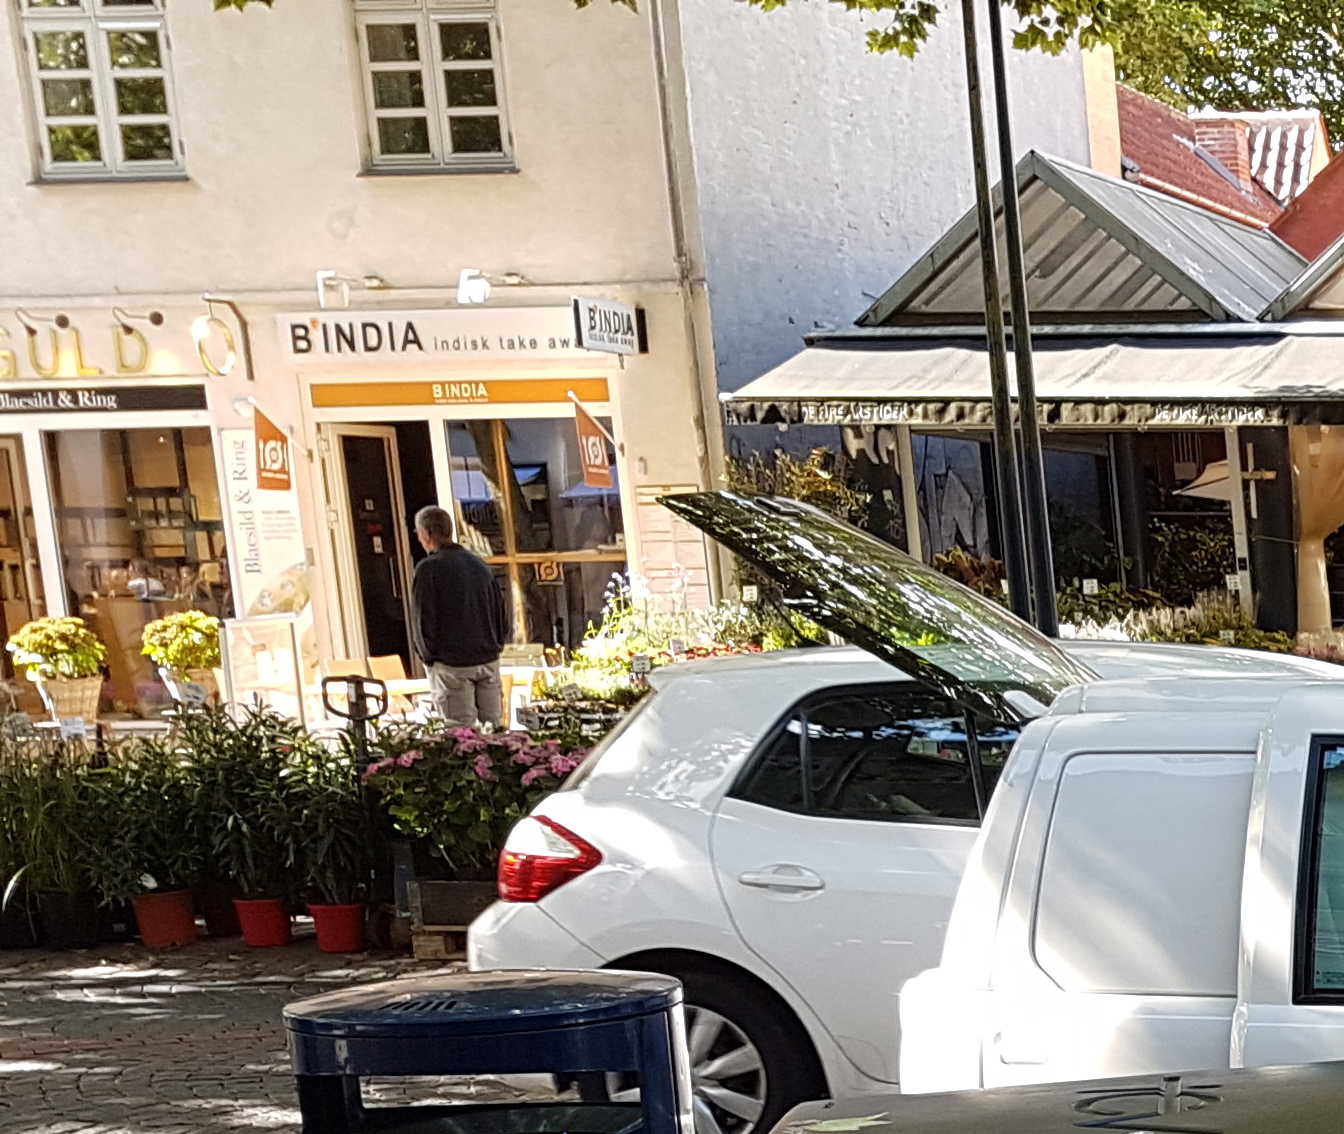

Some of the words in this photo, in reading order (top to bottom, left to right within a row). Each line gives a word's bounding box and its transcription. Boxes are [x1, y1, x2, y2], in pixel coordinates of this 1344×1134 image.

[434, 336, 490, 350] indisk
[499, 335, 538, 349] take
[548, 336, 583, 349] aw
[57, 390, 75, 408] &
[77, 389, 118, 409] Ring
